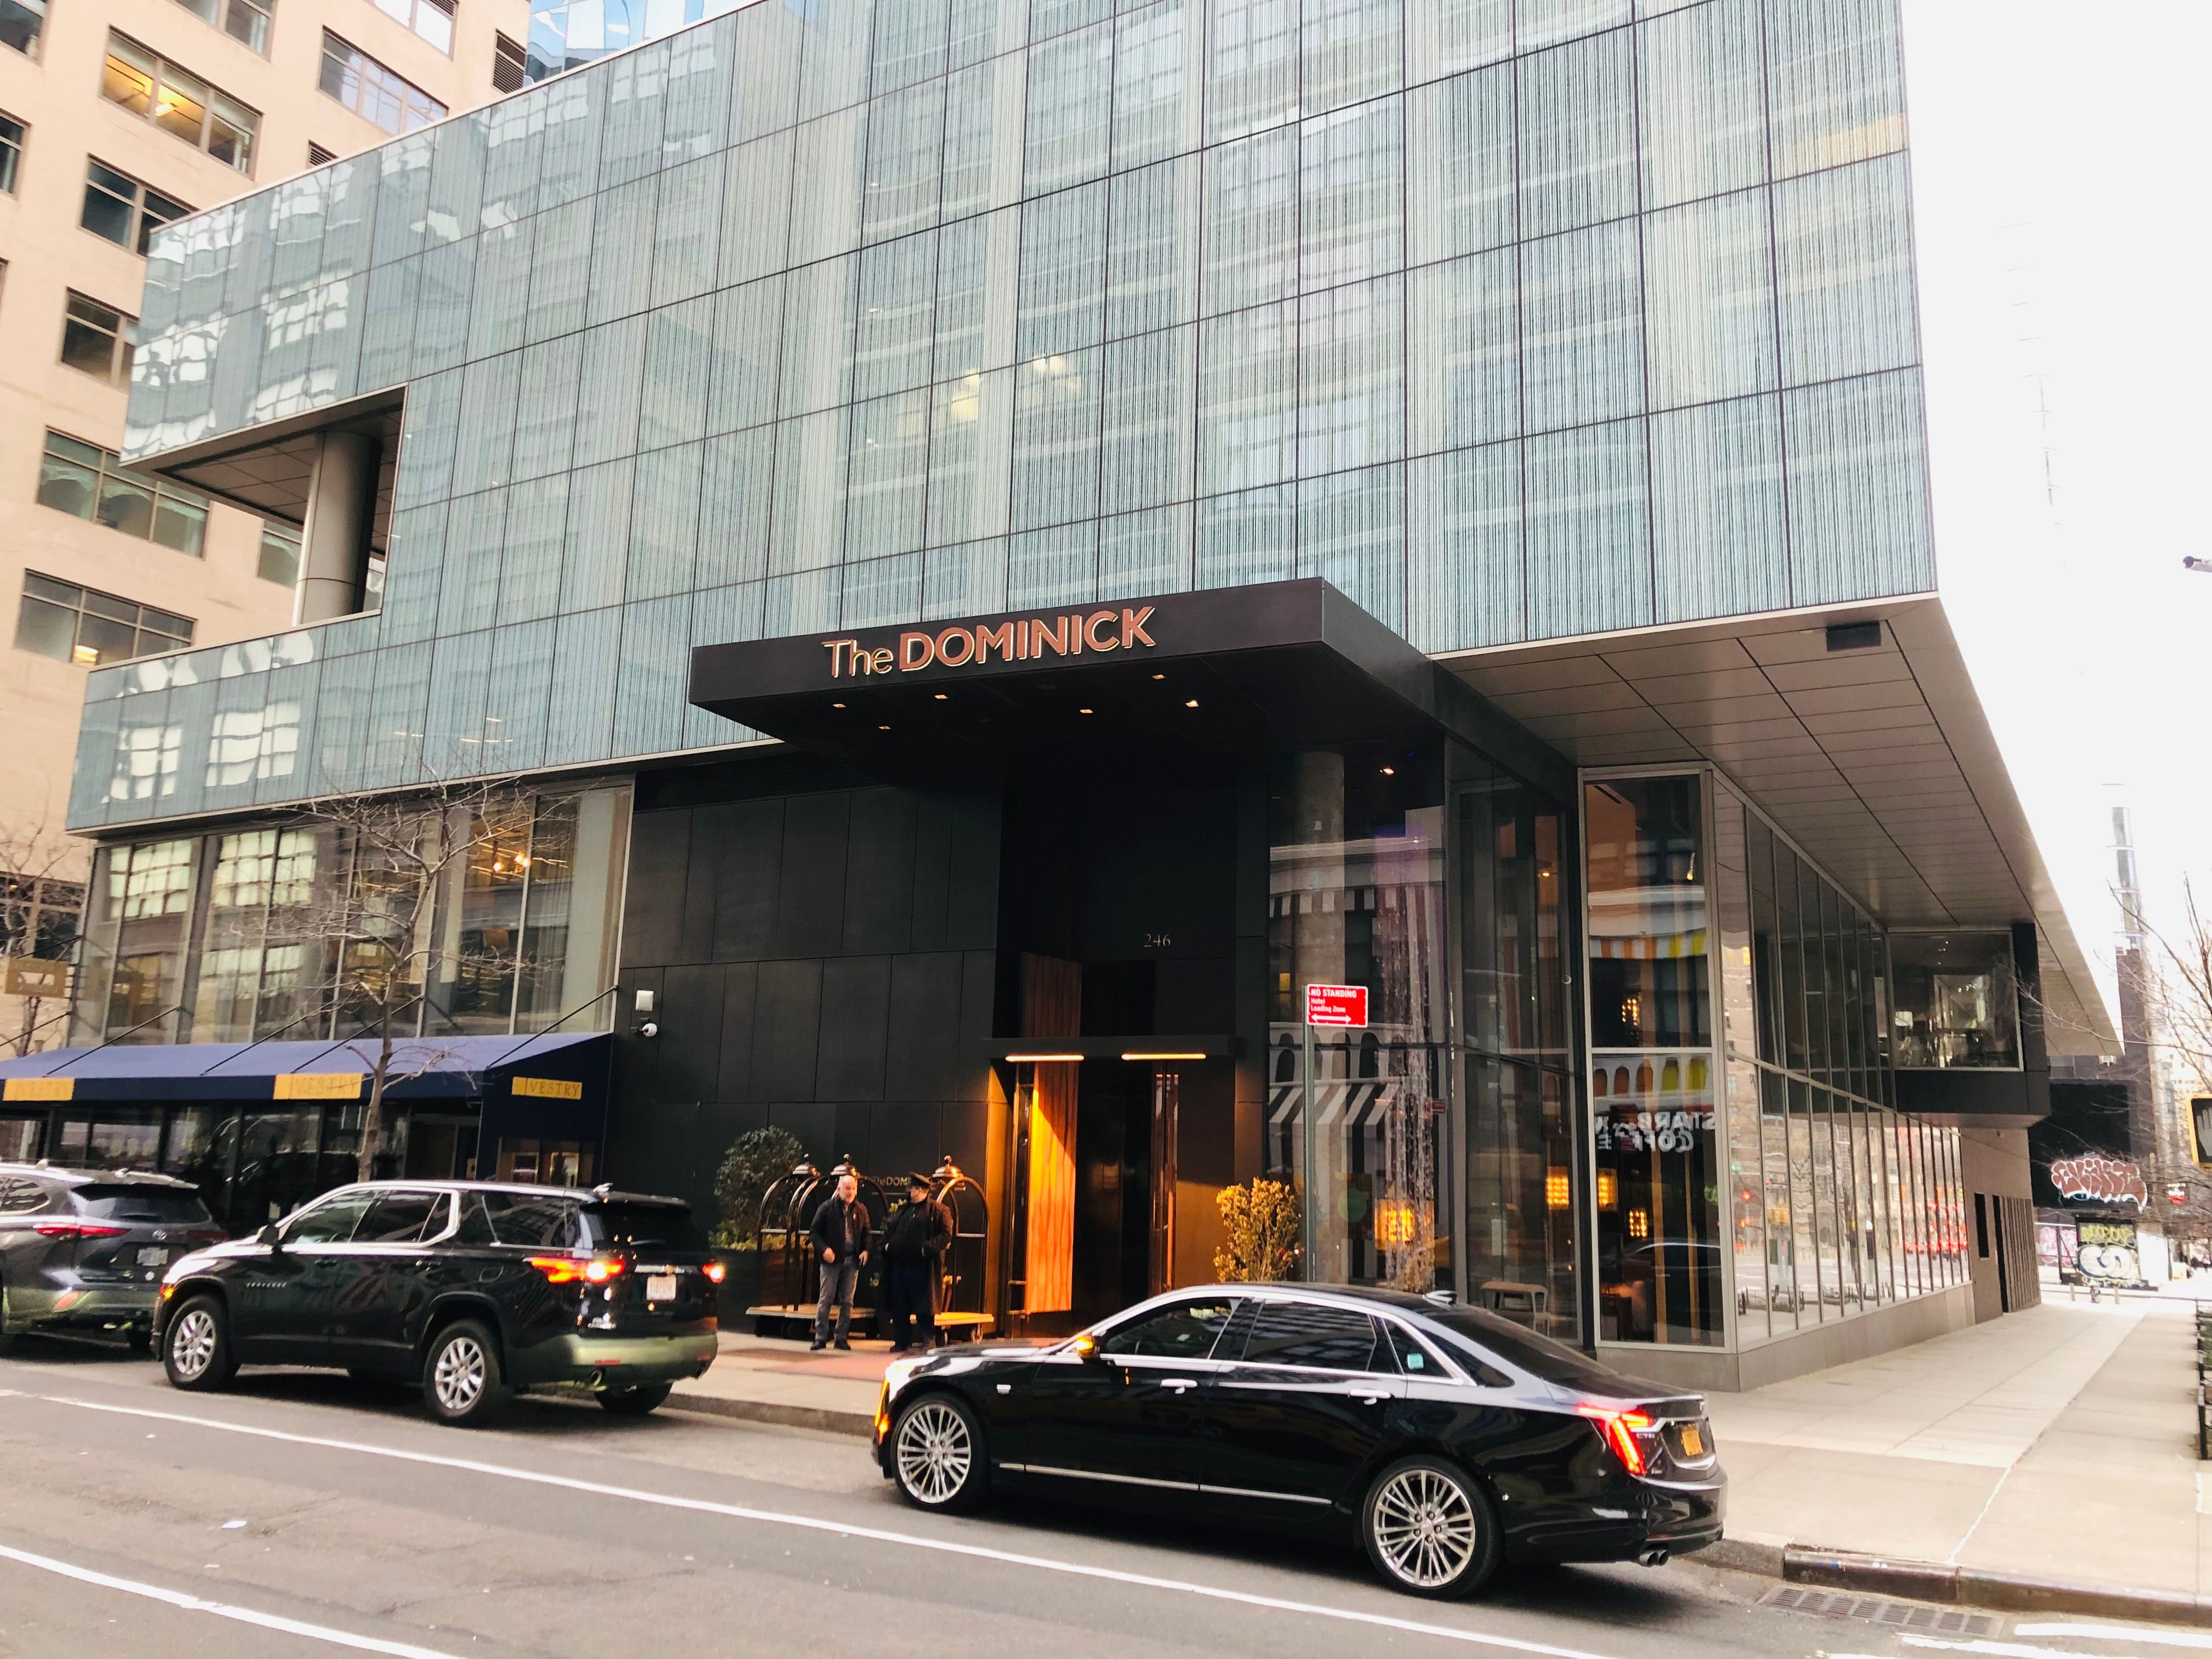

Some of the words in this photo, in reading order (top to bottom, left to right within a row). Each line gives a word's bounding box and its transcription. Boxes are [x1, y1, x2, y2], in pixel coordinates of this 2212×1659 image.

[821, 639, 893, 678] The
[899, 606, 1156, 673] DOMINICK
[1143, 933, 1171, 947] 246
[1310, 988, 1321, 997] NO
[1322, 989, 1357, 998] STANDING
[1311, 1005, 1331, 1013] Loading
[1332, 1005, 1346, 1013] Zone
[295, 1076, 357, 1095] VESTRY
[529, 1081, 580, 1097] VESTRY
